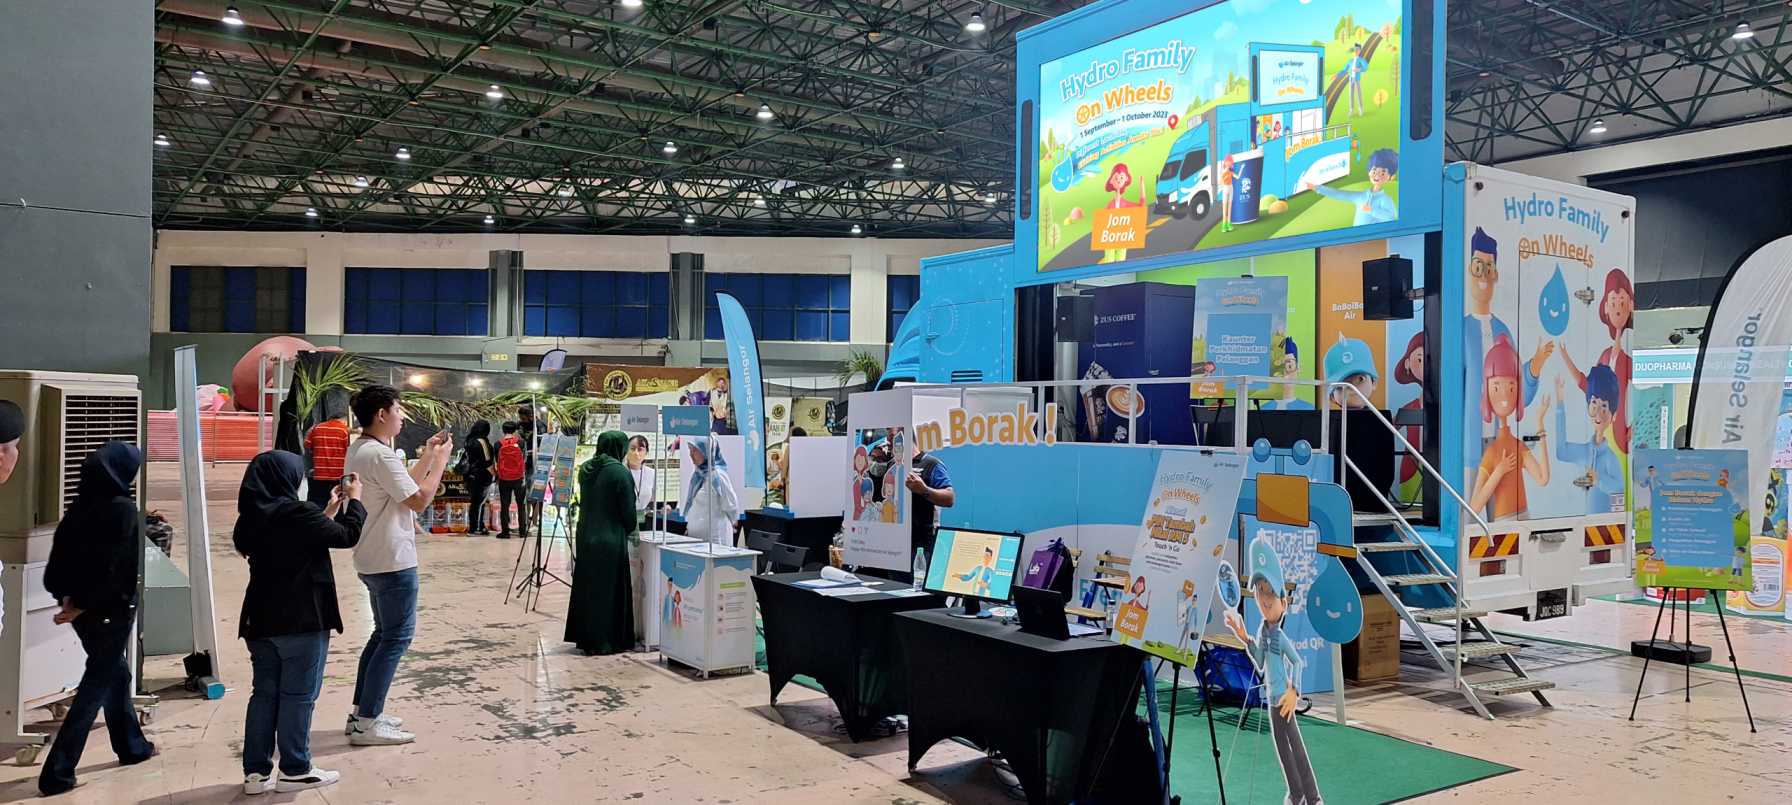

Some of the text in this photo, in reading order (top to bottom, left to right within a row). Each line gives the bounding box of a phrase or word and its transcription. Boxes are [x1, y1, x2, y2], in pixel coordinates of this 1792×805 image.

[1061, 40, 1195, 99] Hydro Family
[1076, 80, 1172, 124] On Wheels
[1084, 119, 1117, 138] September
[1126, 112, 1152, 122] October
[1107, 213, 1131, 229] Jom
[1504, 192, 1609, 243] Hydro Family
[1101, 227, 1136, 243] Borak
[1519, 234, 1594, 268] On Wheels
[1344, 311, 1356, 320] Air
[738, 344, 753, 406] Selangor
[1635, 360, 1692, 371] DUOPHARMA
[950, 403, 1039, 447] Borak
[1125, 608, 1140, 620] Jom
